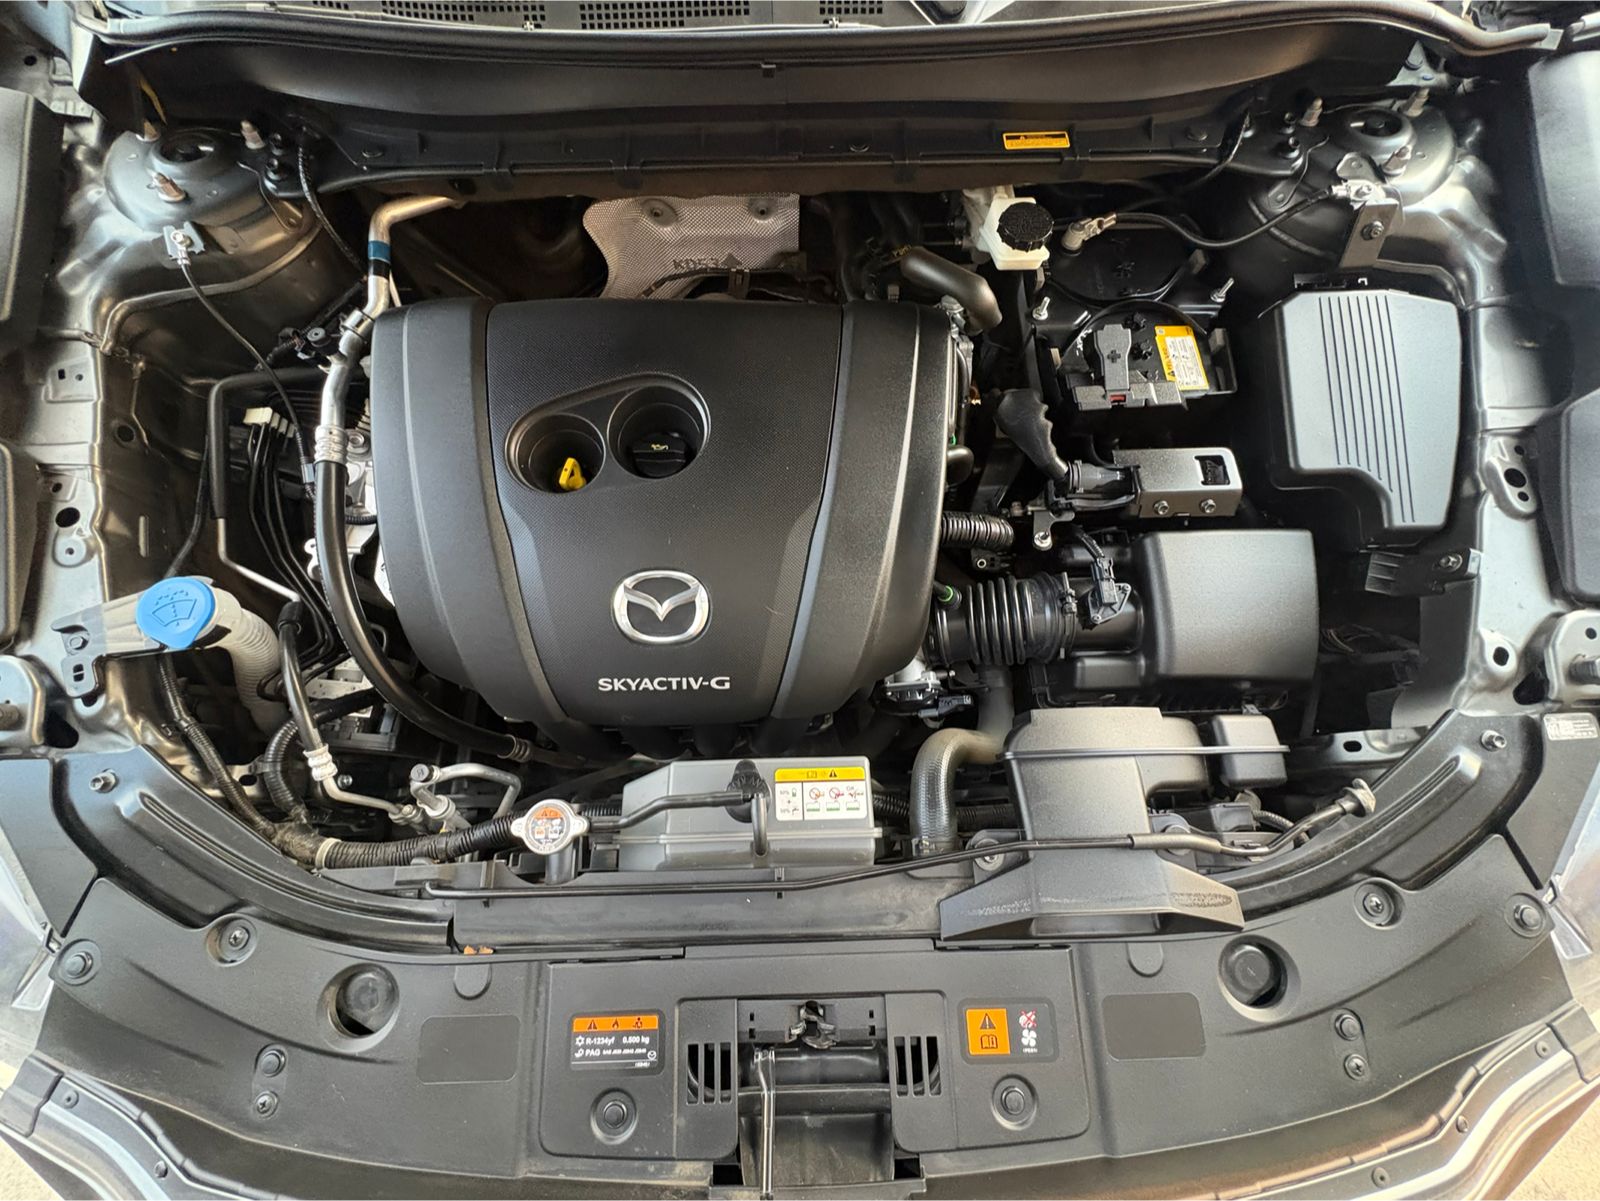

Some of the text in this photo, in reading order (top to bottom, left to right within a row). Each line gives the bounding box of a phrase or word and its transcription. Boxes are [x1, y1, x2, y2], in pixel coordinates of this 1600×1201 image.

[597, 676, 731, 692] SKYACTIV-G
[586, 1036, 615, 1046] R-1234yf
[641, 1035, 650, 1044] kg
[585, 1048, 601, 1057] PAG
